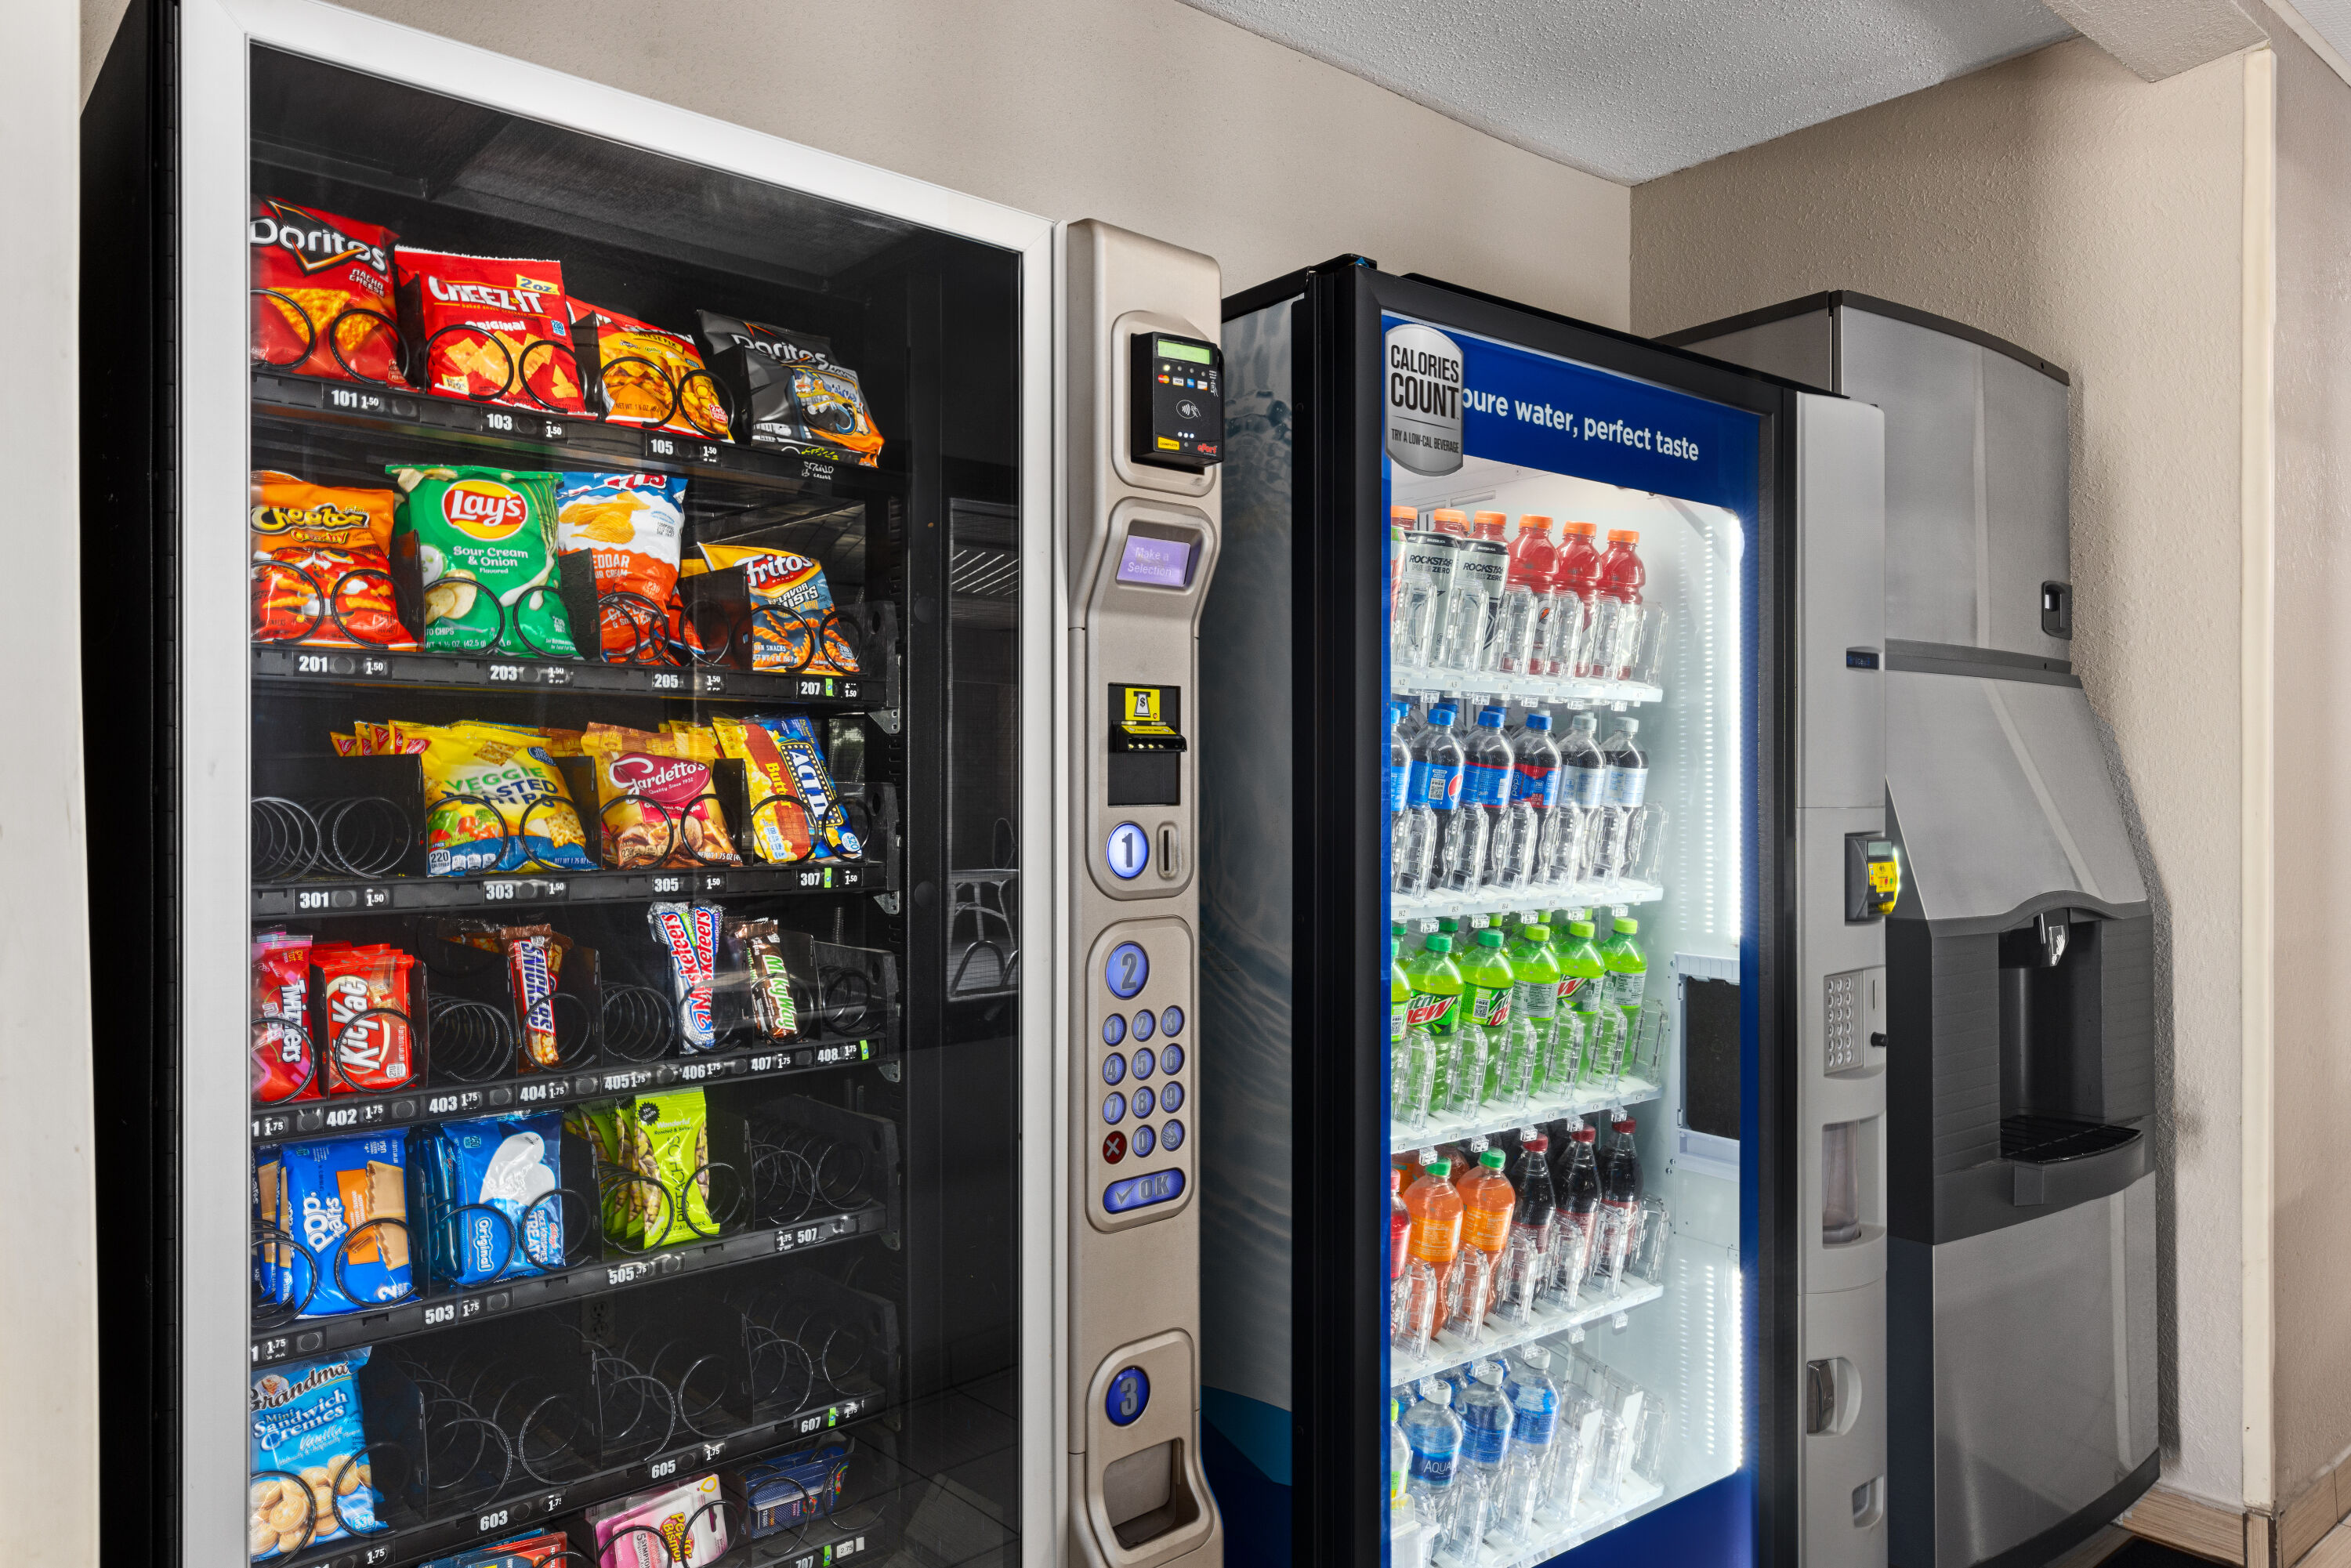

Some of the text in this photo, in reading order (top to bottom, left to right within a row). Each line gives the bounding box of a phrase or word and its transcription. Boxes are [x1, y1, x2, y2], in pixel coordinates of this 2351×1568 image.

[250, 218, 386, 272] Doritos
[349, 274, 386, 298] CHEESE
[352, 268, 384, 291] NACHO
[731, 334, 829, 371] Doritos
[1389, 343, 1459, 383] CALORIES
[331, 389, 379, 409] 101 1.50
[1389, 372, 1459, 420] COUNT
[487, 414, 562, 437] 103 1.50
[1515, 400, 1578, 438] water,
[1584, 417, 1651, 451] perfect
[1655, 430, 1700, 462] taste
[651, 439, 717, 457] 105 1.50
[1392, 428, 1459, 454] TRY A LOW-CAL BEVERAGE
[251, 506, 364, 531] Cheetos
[451, 490, 520, 527] Lay's
[453, 545, 529, 559] Sour Cream
[468, 556, 518, 567] & Onion
[1135, 547, 1169, 561] Make a
[1409, 555, 1454, 567] ROCKSTAR
[734, 553, 813, 587] Fritos
[1128, 561, 1172, 577] Selection
[1432, 566, 1451, 575] ZERO
[773, 582, 810, 603] FLAVOR
[435, 628, 455, 636] CHIPS
[299, 656, 384, 674] 201 1.50
[490, 665, 517, 681] 203
[654, 674, 721, 688] 205 1.50
[801, 682, 820, 694] 207
[445, 766, 547, 792] VEGGIE
[789, 750, 822, 795] ACT
[1511, 771, 1520, 797] pepsi
[430, 851, 449, 863] 220
[1121, 832, 1133, 867] 1
[654, 878, 721, 893] 305 1.50
[800, 873, 857, 886] 307 1.50
[299, 892, 384, 908] 301 1.50
[486, 882, 564, 900] 303 1.50
[1121, 951, 1137, 991] 2
[775, 996, 798, 1031] Way
[1165, 1010, 1175, 1033] 3
[1107, 1018, 1117, 1042] 1
[1136, 1015, 1147, 1037] 2
[751, 1056, 791, 1070] 407 1.75
[817, 1045, 857, 1062] 408 1.75
[1136, 1052, 1147, 1076] 5
[1165, 1048, 1176, 1071] 6
[682, 1063, 721, 1080] 406 1.75
[1107, 1057, 1118, 1080] 4
[605, 1074, 629, 1090] 405
[429, 1094, 477, 1113] 403 1.75
[520, 1086, 564, 1102] 404 1.75
[1136, 1092, 1147, 1114] 8
[1165, 1086, 1176, 1108] 9
[326, 1105, 383, 1126] 402 1.75
[643, 1109, 657, 1120] Shells
[1108, 1097, 1118, 1120] 7
[265, 1120, 283, 1135] 1.75
[657, 1117, 690, 1129] Wonderful
[470, 1135, 481, 1148] 250
[1137, 1129, 1148, 1153] 0
[1139, 1175, 1170, 1200] OK
[476, 1219, 494, 1271] Original
[539, 1226, 548, 1263] KRISPIES
[779, 1227, 818, 1246] 1.75 507
[609, 1268, 635, 1285] 505
[378, 1285, 397, 1300] 2
[425, 1302, 480, 1324] 503 1.75
[267, 1338, 286, 1354] 1.75
[1119, 1377, 1139, 1417] 3
[254, 1389, 349, 1439] Sandwich
[265, 1408, 294, 1423] Mini
[801, 1417, 821, 1432] 607
[260, 1404, 346, 1451] Cremes
[299, 1424, 343, 1450] Vanilla
[651, 1447, 720, 1479] 605 1.75
[480, 1510, 509, 1531] 603
[636, 1533, 647, 1541] 5
[367, 1548, 385, 1564] 1.75
[840, 1544, 853, 1554] 2.75
